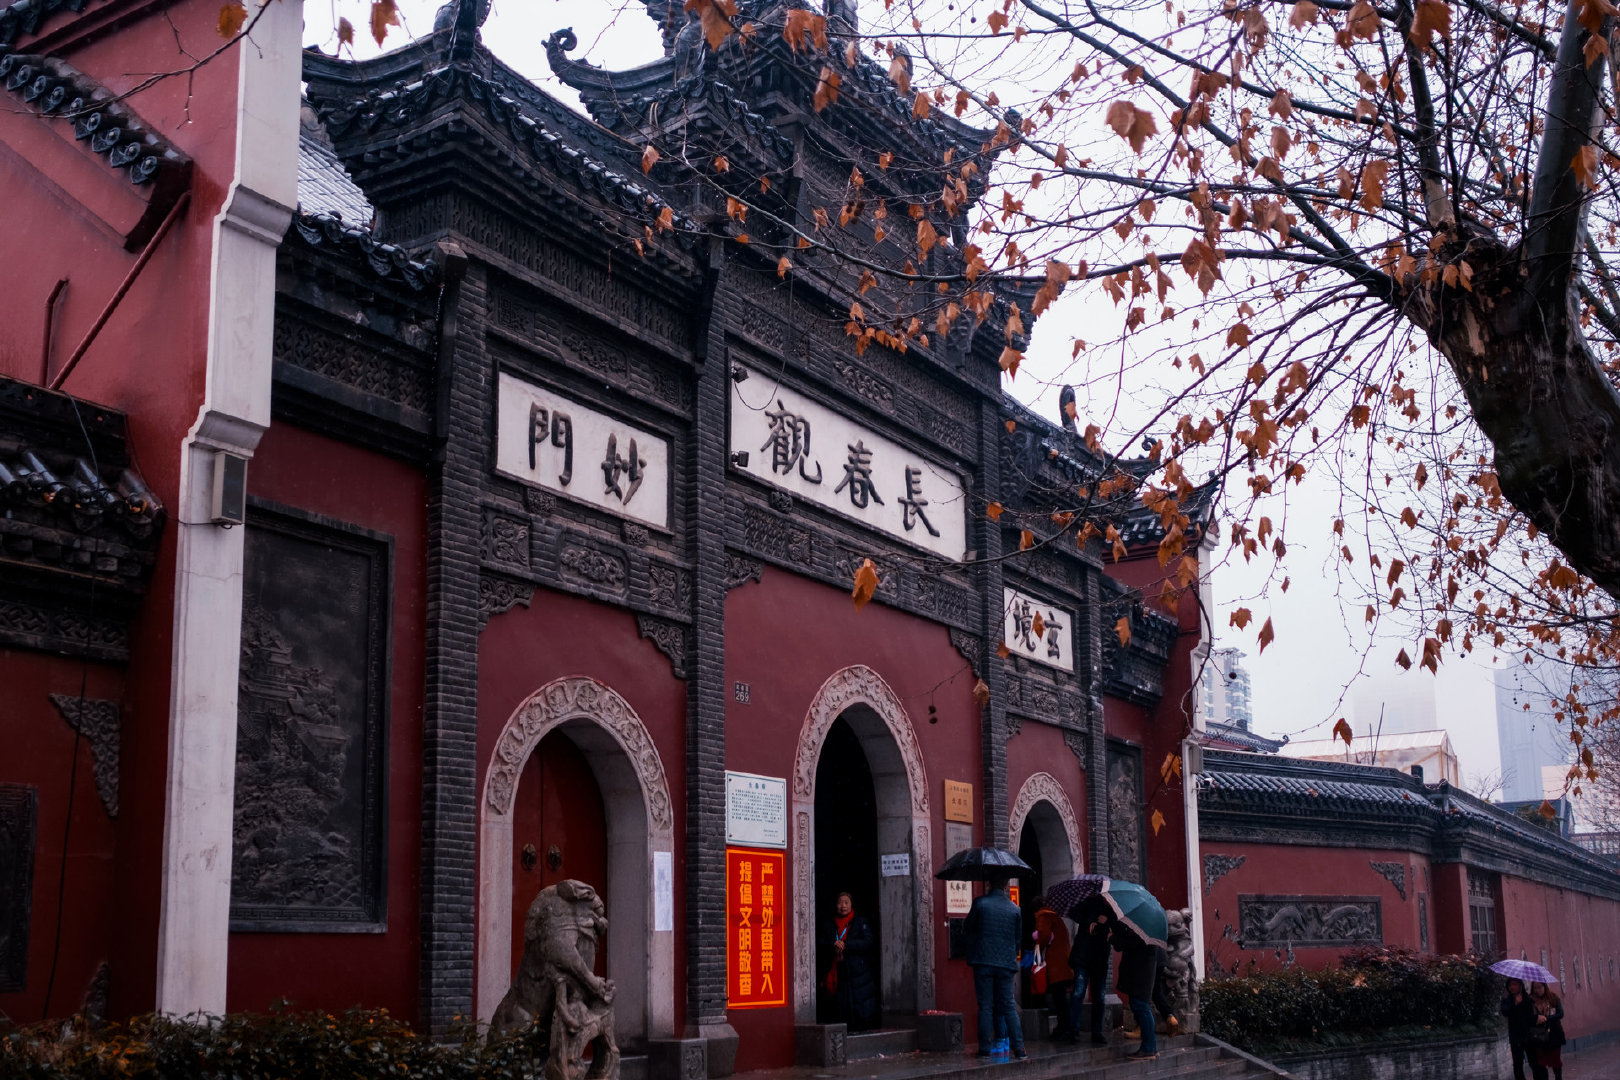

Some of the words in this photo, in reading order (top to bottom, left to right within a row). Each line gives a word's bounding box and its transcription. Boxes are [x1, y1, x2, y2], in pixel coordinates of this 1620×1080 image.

[735, 690, 750, 703] 269
[739, 860, 752, 996] 提倡文明敬香
[761, 862, 773, 995] 严禁外香带入
